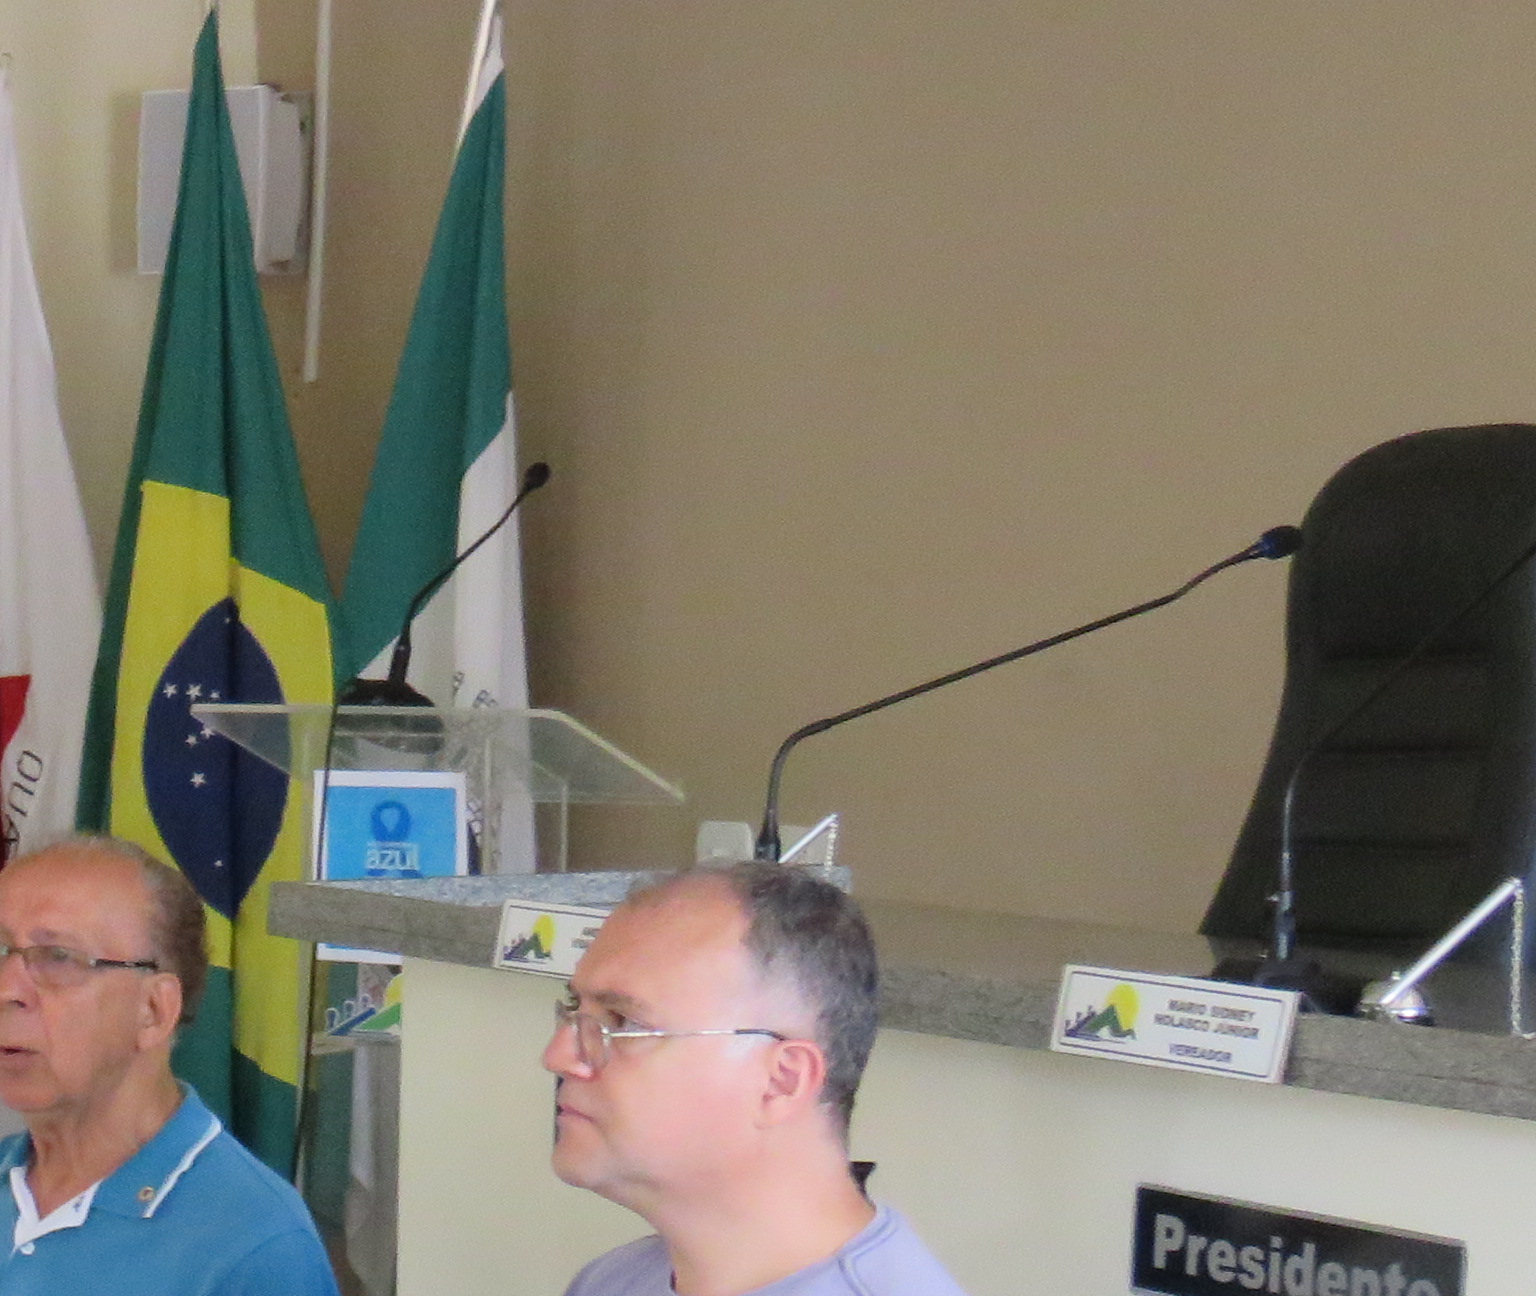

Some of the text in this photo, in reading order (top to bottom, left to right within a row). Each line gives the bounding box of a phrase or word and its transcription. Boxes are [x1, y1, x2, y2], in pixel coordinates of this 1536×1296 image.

[365, 844, 419, 870] azul
[1168, 999, 1207, 1016] MARIO
[1154, 1012, 1260, 1039] NOLASCO JUNIOR
[1168, 1042, 1232, 1063] VEREADOR
